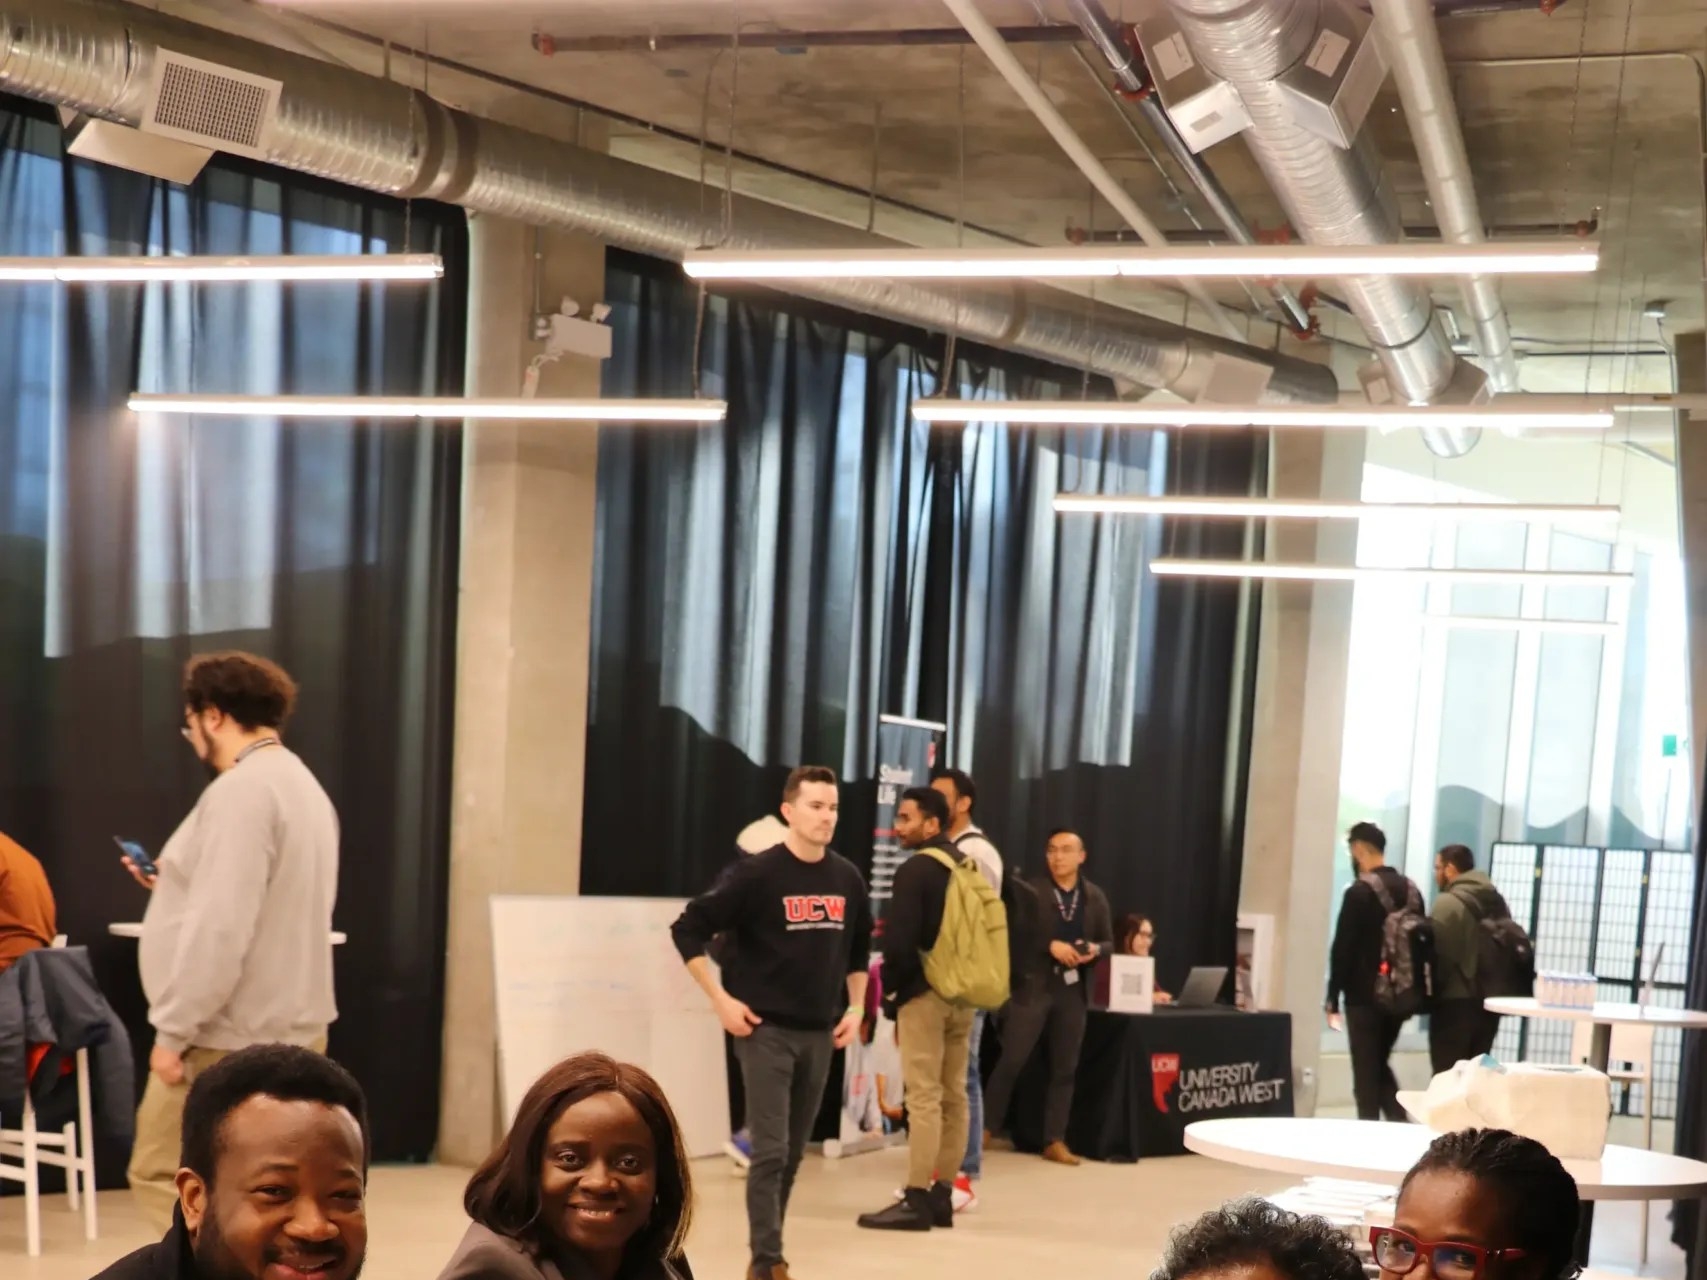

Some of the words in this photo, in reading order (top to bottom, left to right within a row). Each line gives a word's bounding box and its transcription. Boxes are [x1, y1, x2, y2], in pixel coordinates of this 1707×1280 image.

[782, 895, 846, 922] UCW
[1179, 1061, 1259, 1090] UNIVERSITY
[1178, 1086, 1237, 1112] CANADA
[1239, 1079, 1284, 1104] WEST
